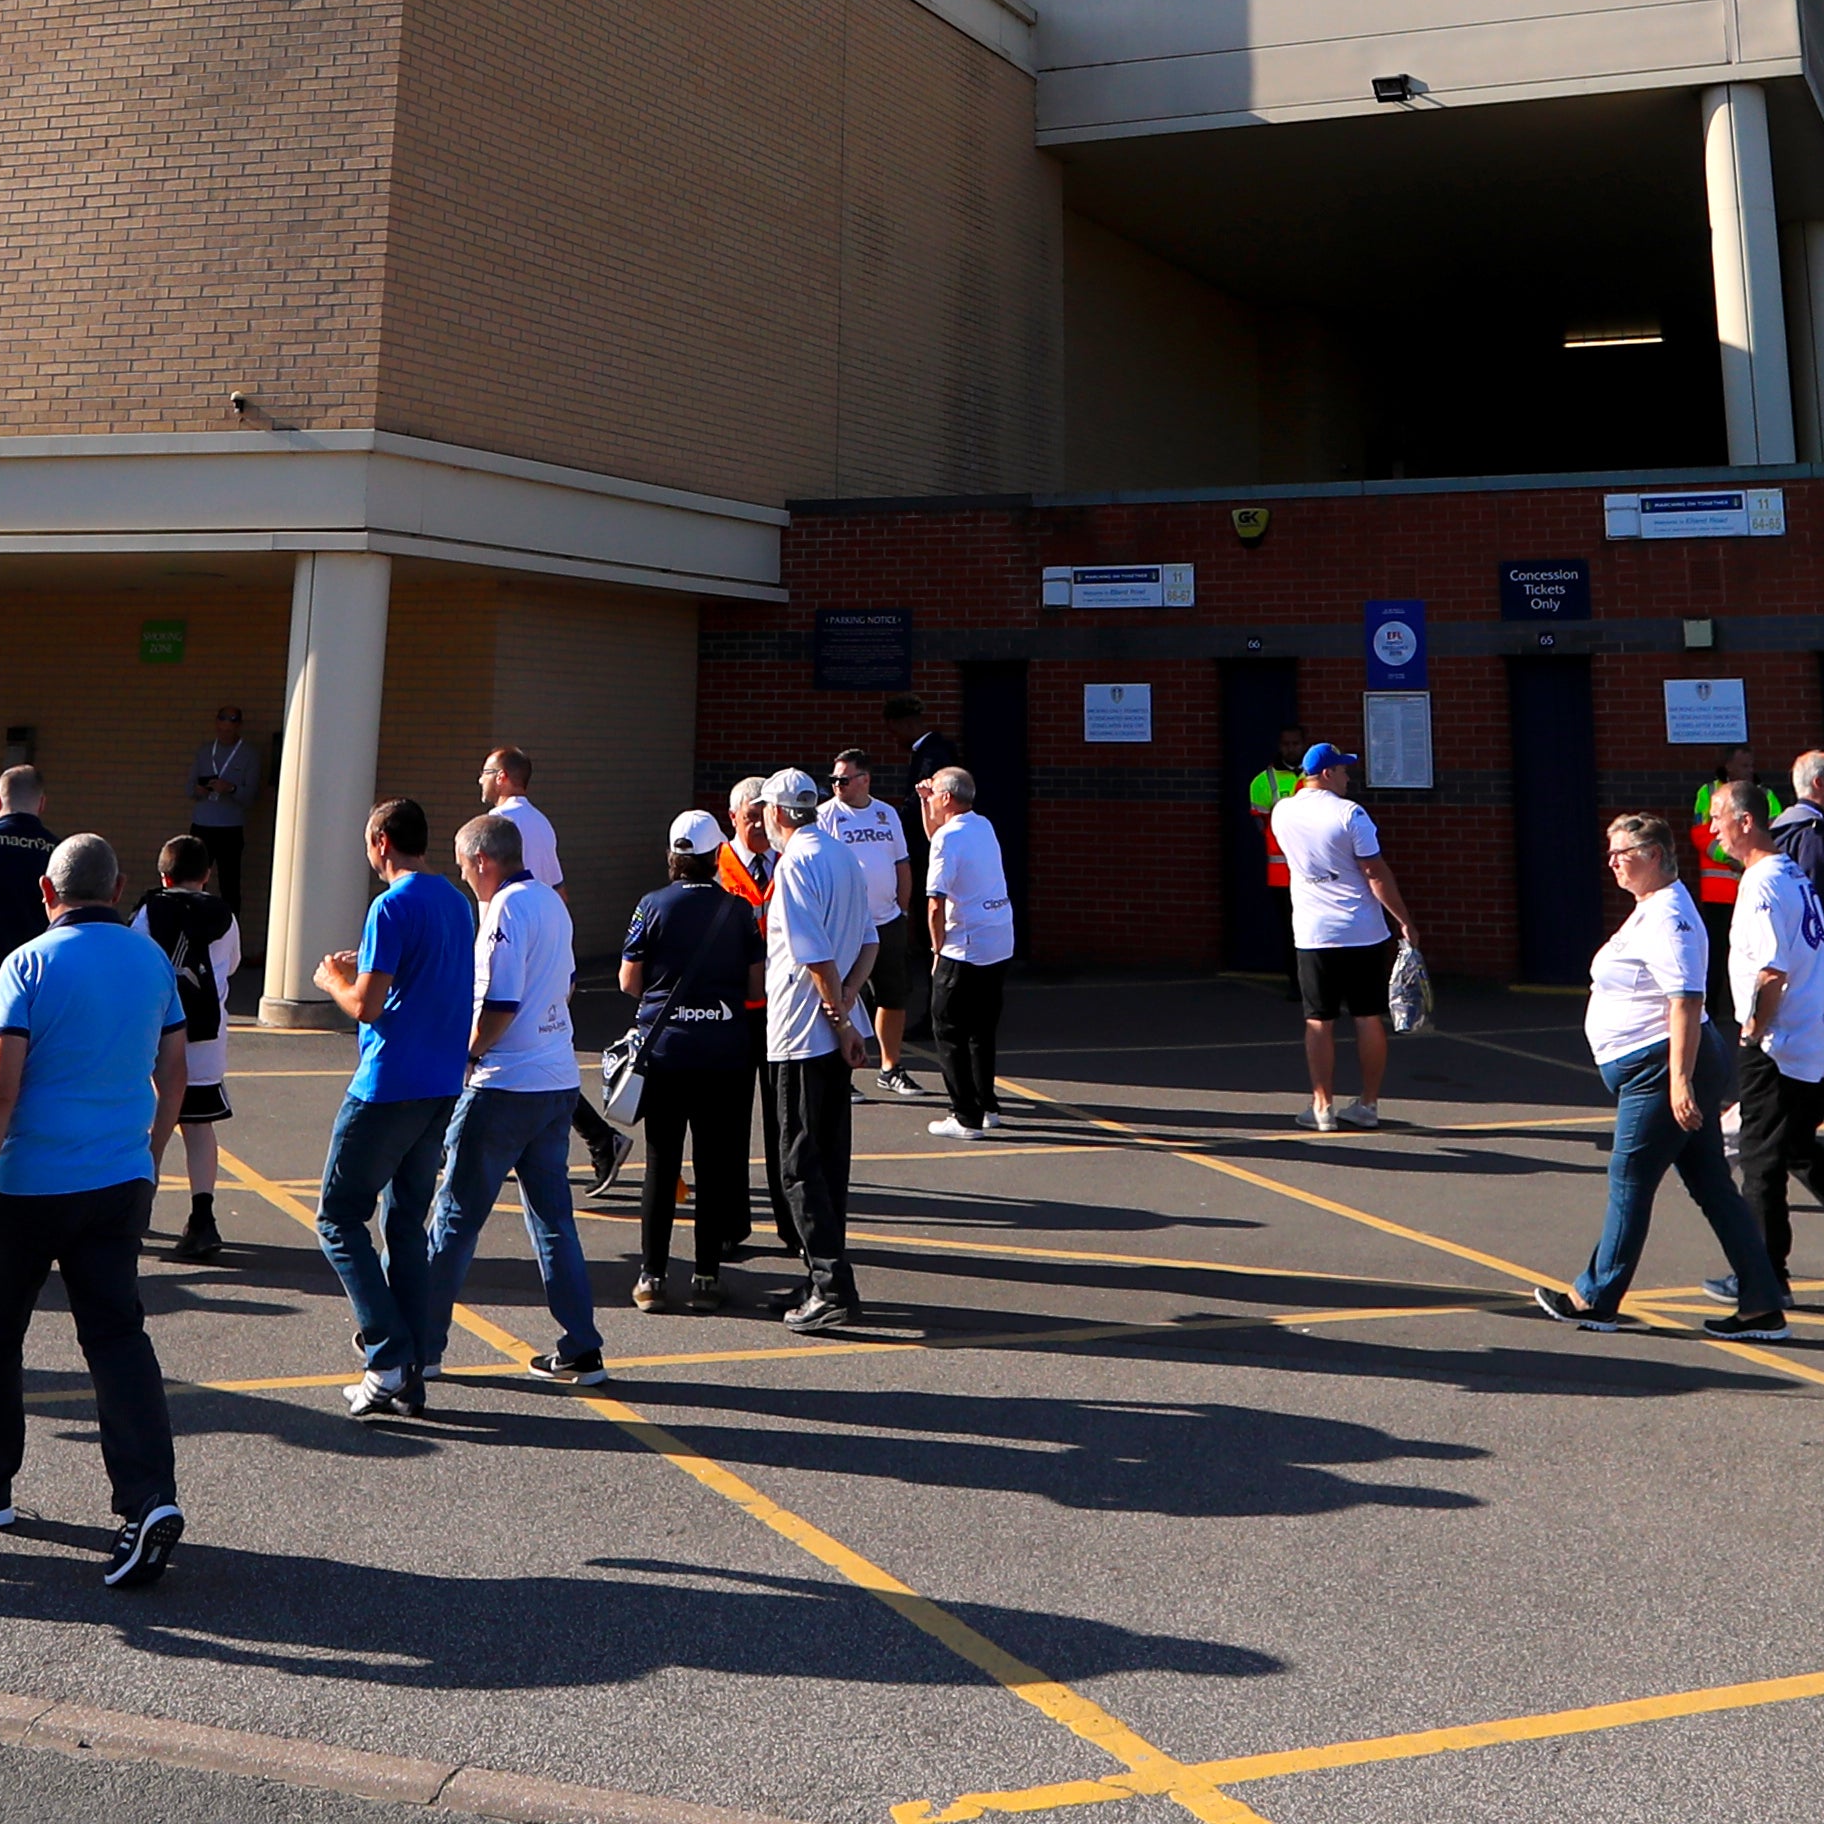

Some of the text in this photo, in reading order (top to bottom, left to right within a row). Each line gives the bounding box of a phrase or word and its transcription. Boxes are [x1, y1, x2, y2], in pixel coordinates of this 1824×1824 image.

[1509, 569, 1579, 582] Concession
[1523, 583, 1566, 595] Tickets
[1530, 598, 1560, 612] Only
[829, 615, 897, 625] PARKING NOTICE
[143, 631, 183, 642] SMOKING
[1540, 635, 1554, 645] 65
[149, 643, 174, 654] ZONE
[1248, 639, 1261, 649] 66
[843, 828, 894, 844] 32Red
